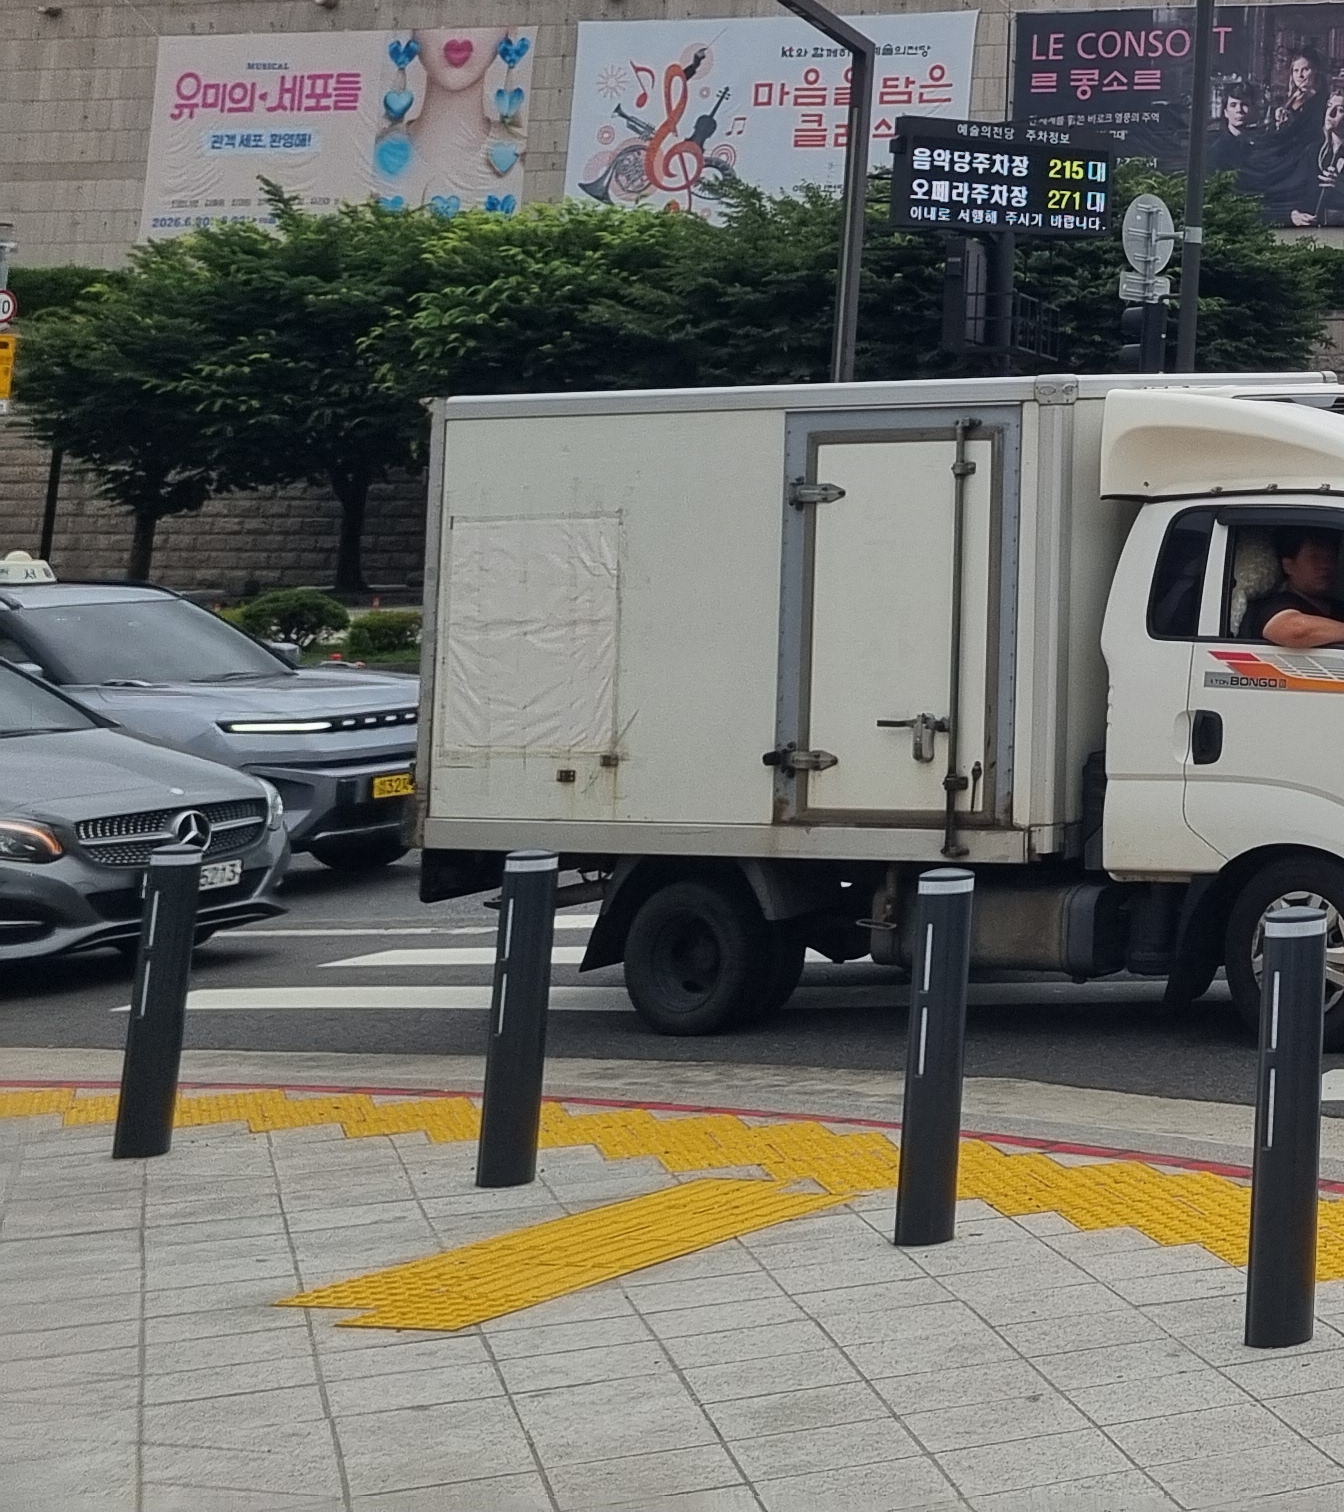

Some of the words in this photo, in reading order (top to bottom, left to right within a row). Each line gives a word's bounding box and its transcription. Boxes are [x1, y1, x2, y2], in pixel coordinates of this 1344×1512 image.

[781, 46, 808, 57] kt와
[811, 46, 852, 58] 함께하
[1031, 33, 1065, 61] LE
[1076, 26, 1233, 60] CONSOT
[246, 62, 291, 70] MUSICAL
[878, 64, 953, 106] 담은
[1030, 71, 1058, 94] 르
[170, 72, 257, 120] 유미의
[266, 72, 362, 113] 세포들
[957, 123, 1014, 140] 예술의전당
[1025, 130, 1071, 145] 주차정보
[911, 147, 1030, 178] 음악당주차장
[1048, 159, 1084, 180] 215
[909, 178, 1028, 208] 오페라주차장
[1047, 190, 1081, 211] 271
[910, 207, 951, 222] 이내로
[957, 208, 997, 225] 서행해
[1005, 212, 1043, 228] 주시기
[1050, 215, 1107, 231] 바랍니다.
[1229, 676, 1278, 688] BONGO
